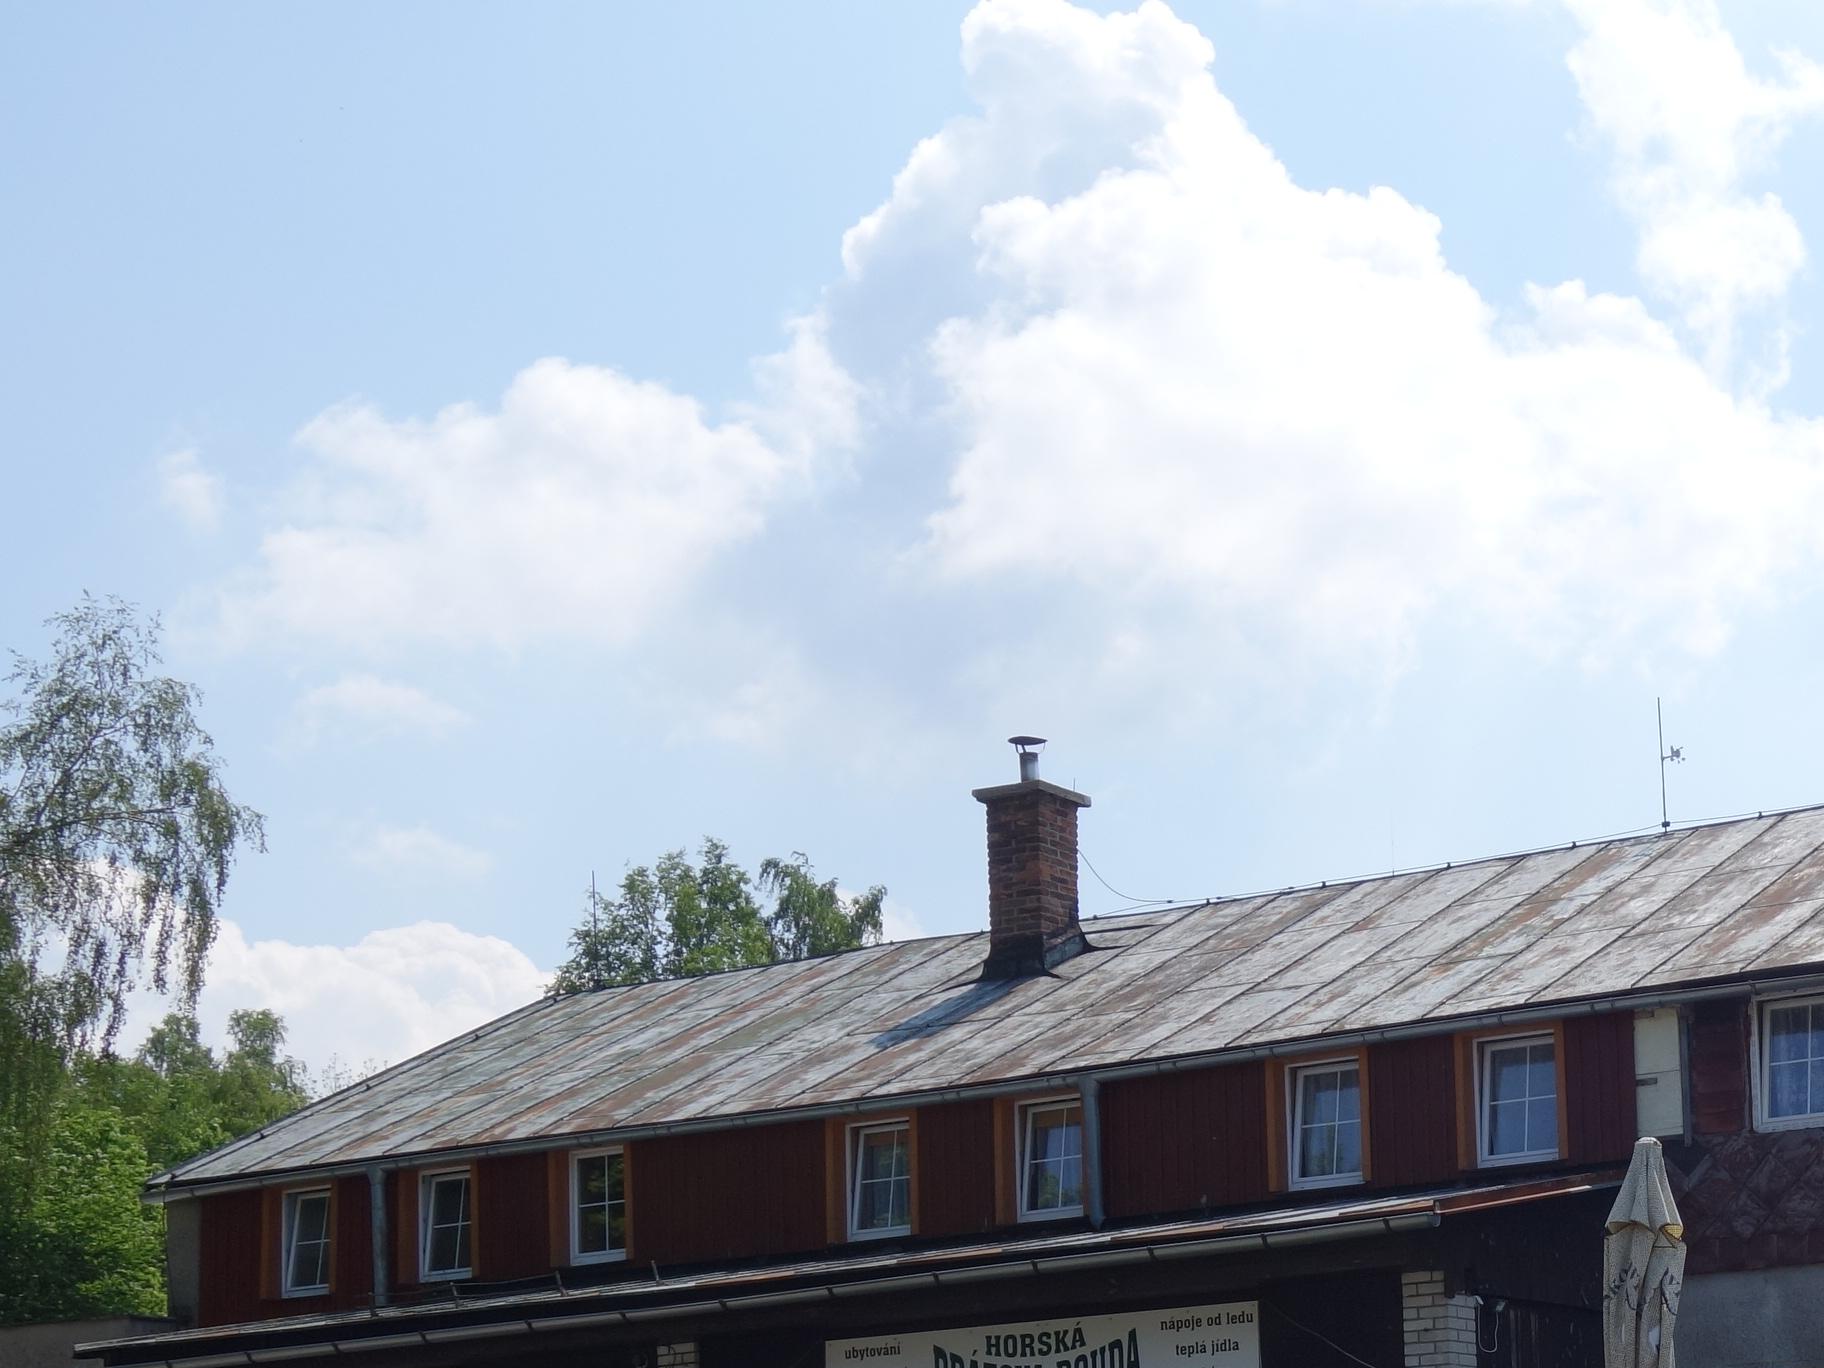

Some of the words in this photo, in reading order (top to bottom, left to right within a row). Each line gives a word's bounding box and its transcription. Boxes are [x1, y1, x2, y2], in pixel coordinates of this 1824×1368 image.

[1160, 1315, 1202, 1332] nápoje
[1206, 1313, 1221, 1327] od
[1226, 1311, 1254, 1325] ledu
[985, 1321, 1086, 1358] HORSKÁ
[1176, 1340, 1207, 1358] teplá
[1211, 1338, 1240, 1356] jídla
[844, 1341, 901, 1360] ubytování
